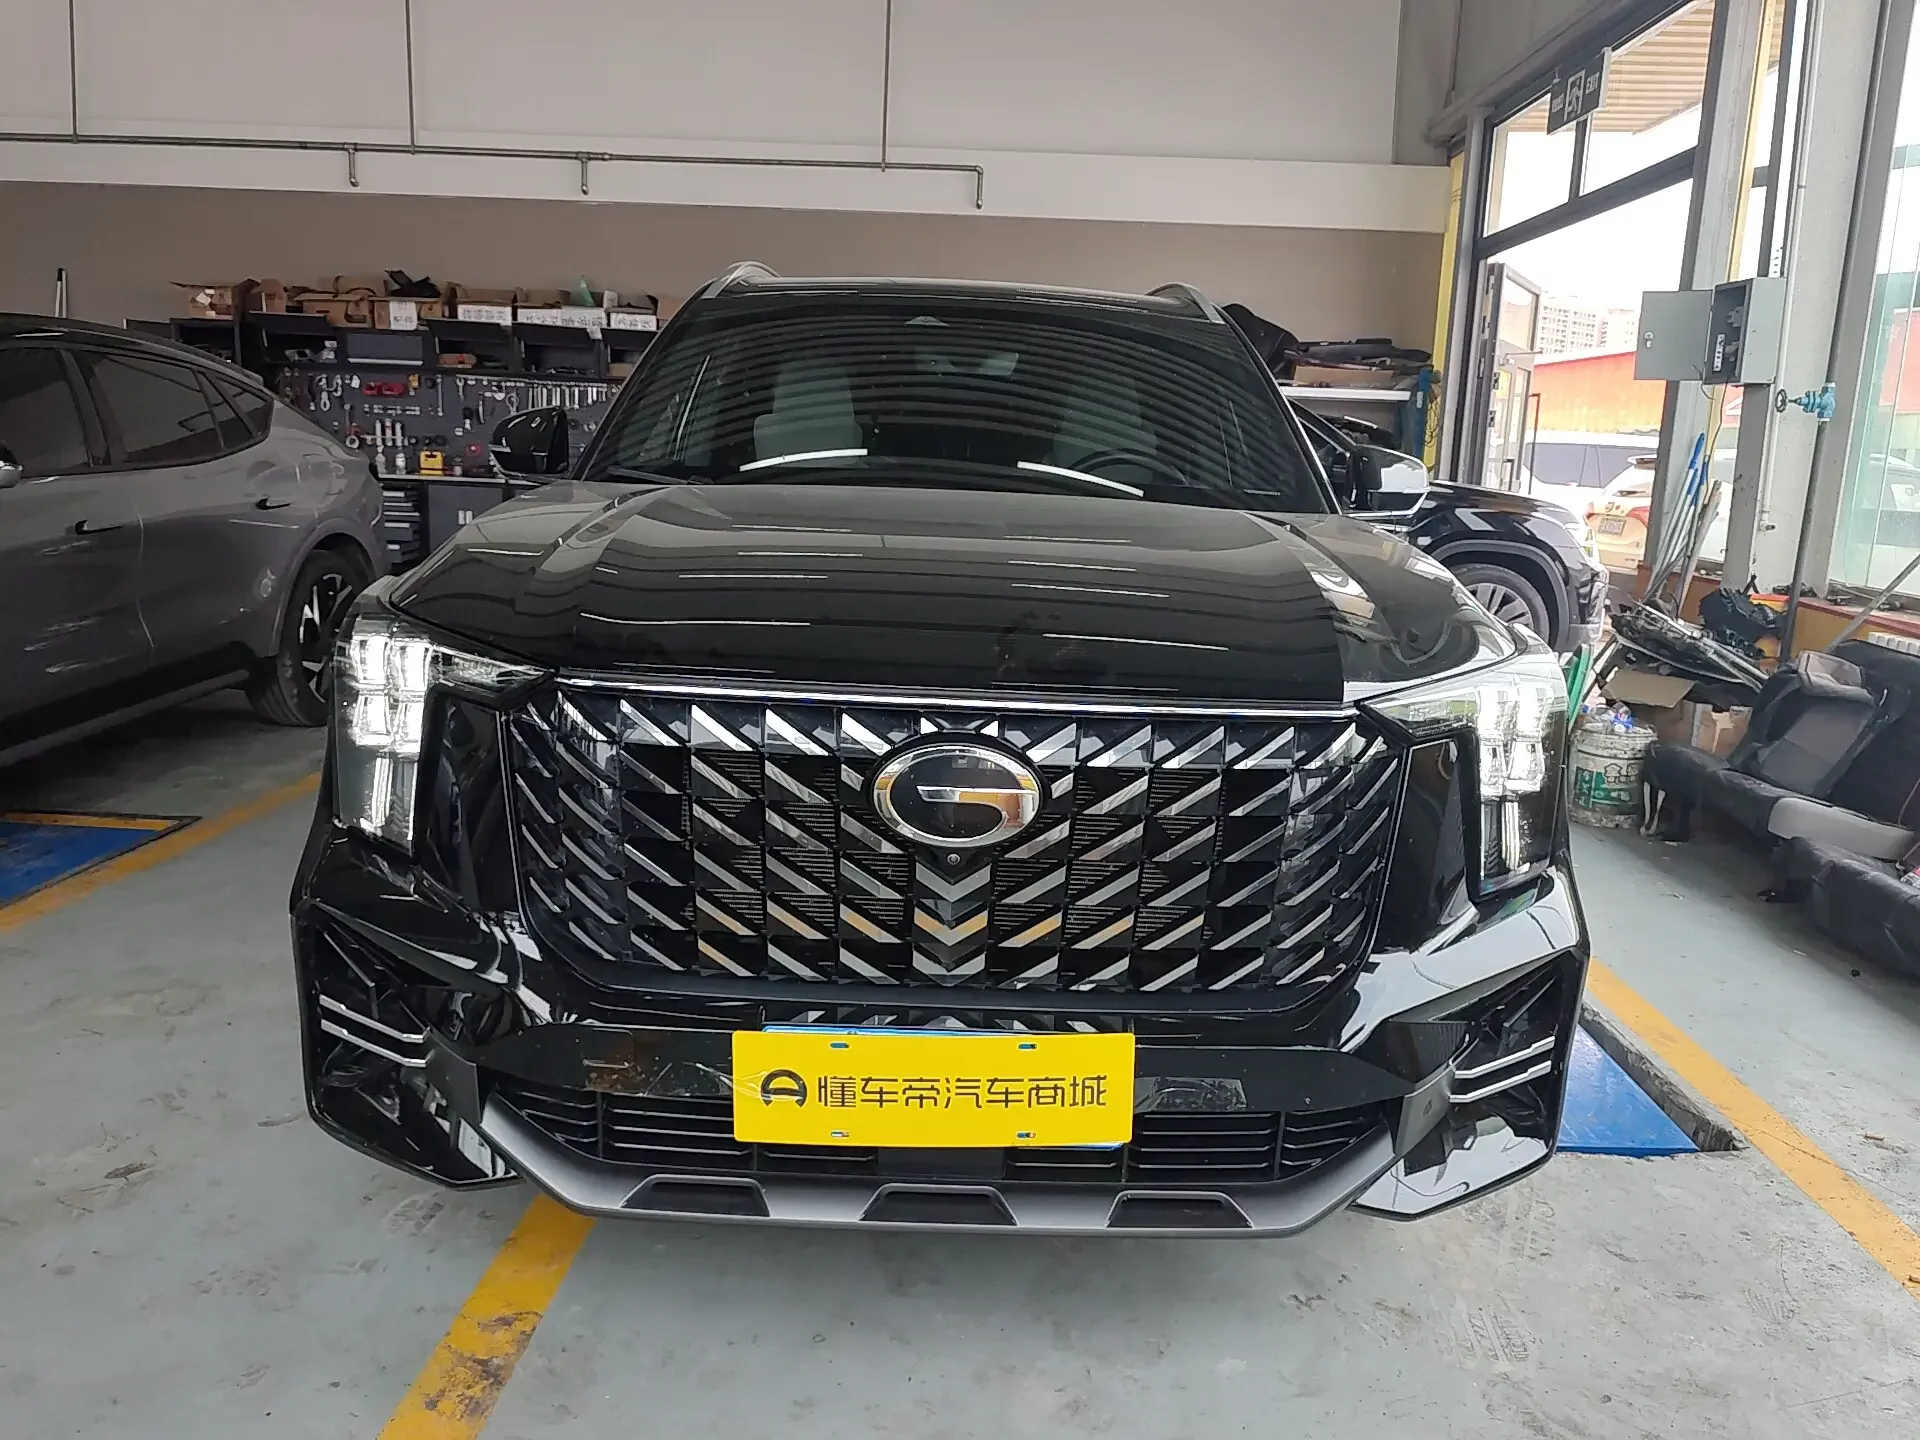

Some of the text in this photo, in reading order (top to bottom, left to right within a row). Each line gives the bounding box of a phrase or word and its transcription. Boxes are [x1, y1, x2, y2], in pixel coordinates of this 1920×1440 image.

[1586, 72, 1600, 95] EXIT
[817, 1074, 1107, 1109] 懂车帝汽车商城
